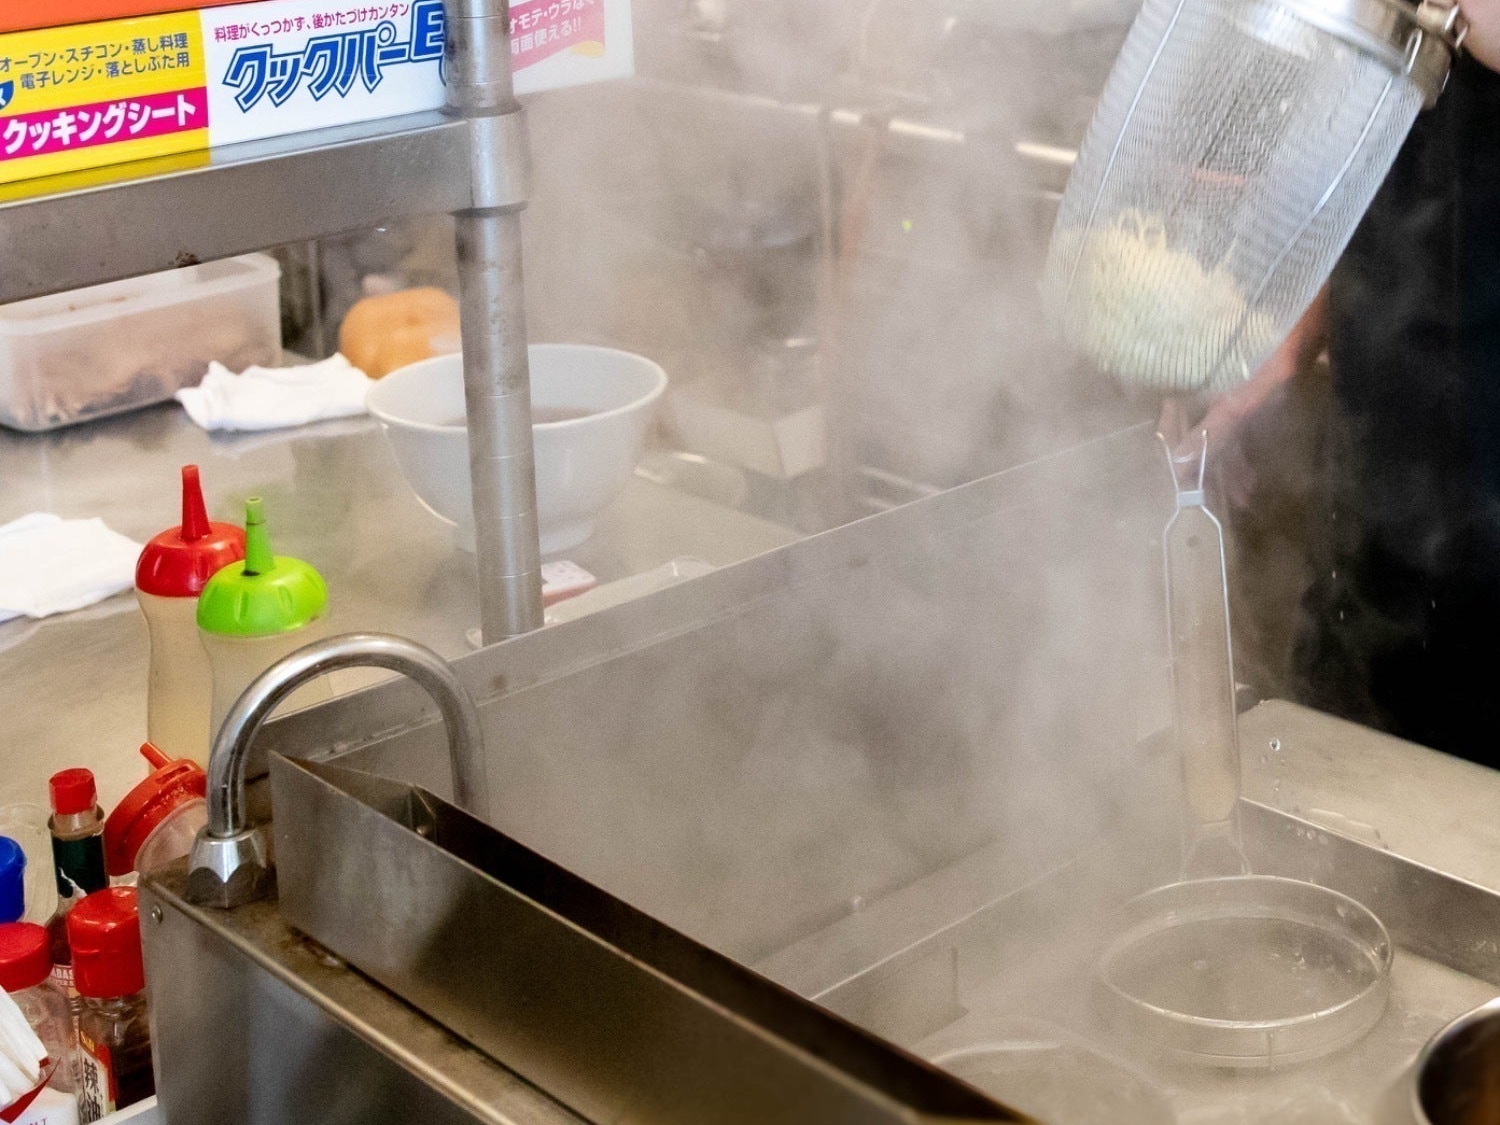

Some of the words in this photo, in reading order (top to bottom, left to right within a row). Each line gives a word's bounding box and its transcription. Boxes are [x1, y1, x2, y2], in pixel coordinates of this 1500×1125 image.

[214, 3, 409, 43] 料理がくっつかず、後かたづけカンタン
[20, 51, 190, 89] 電子レンジ・落としぶた用
[3, 94, 196, 155] クッキングシート
